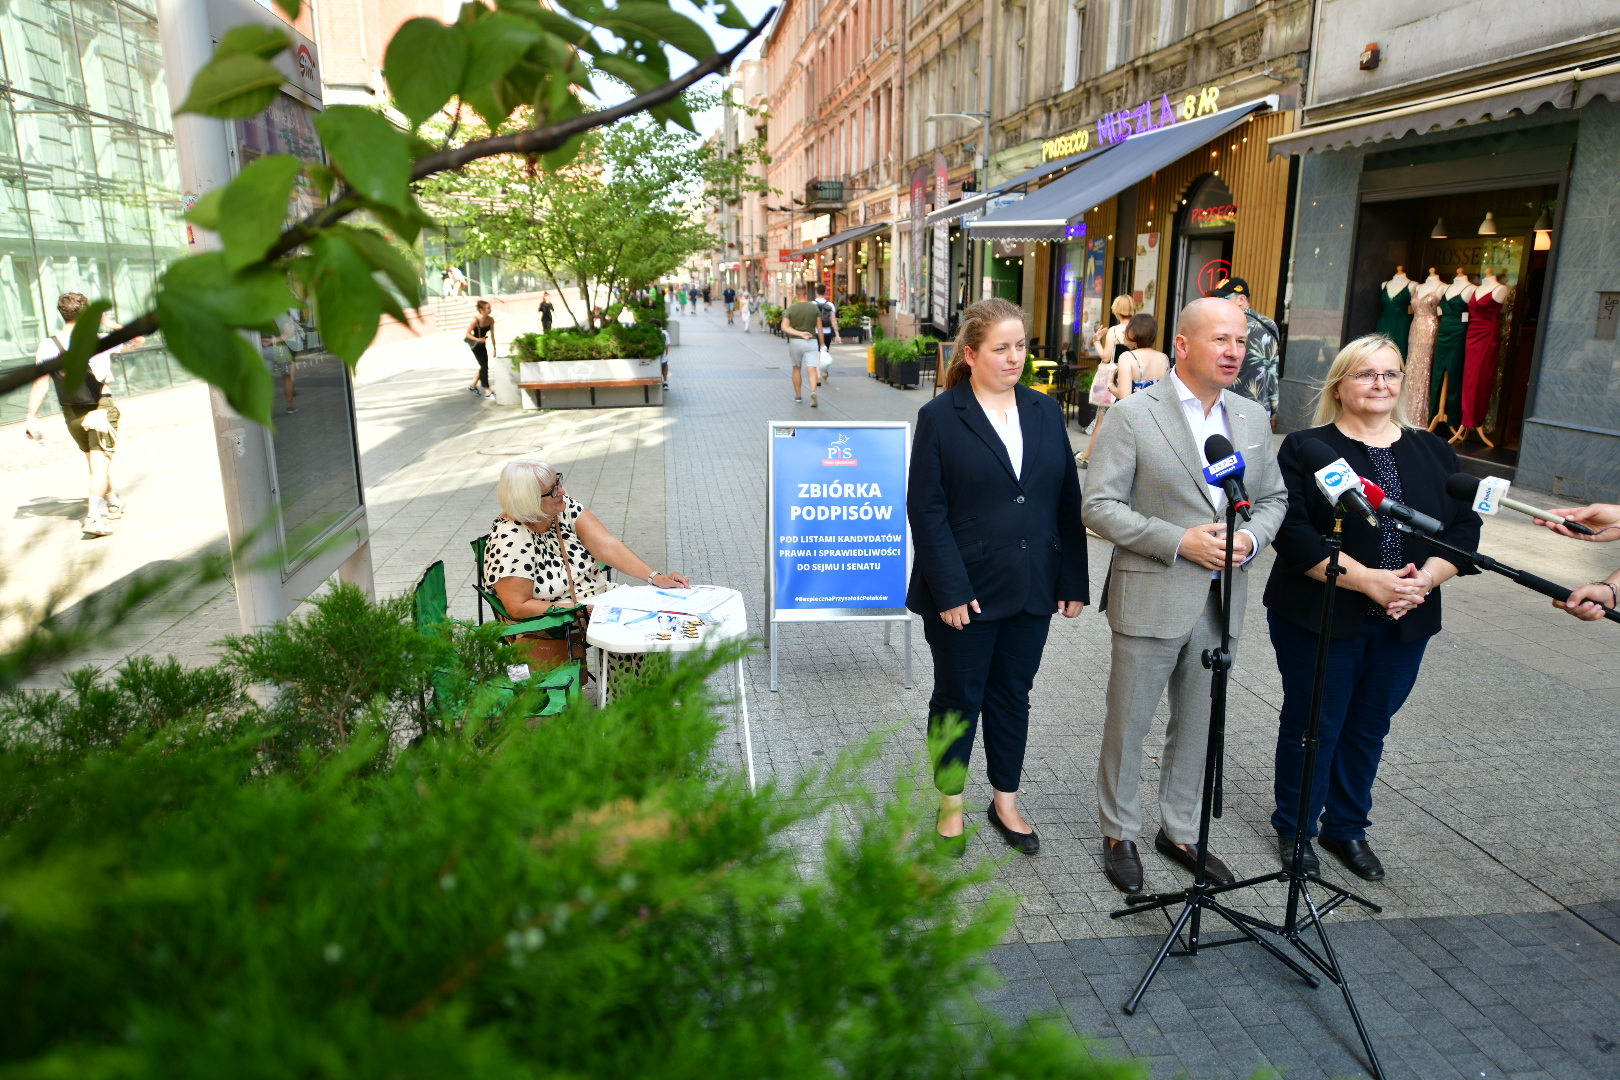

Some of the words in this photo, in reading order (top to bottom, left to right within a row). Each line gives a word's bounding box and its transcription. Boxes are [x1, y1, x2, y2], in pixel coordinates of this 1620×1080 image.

[1042, 129, 1089, 163] PROSECCO
[1097, 93, 1177, 146] MUSZLA
[1182, 86, 1220, 121] BAR
[1191, 204, 1238, 224] PROSECC
[1433, 247, 1512, 265] ROSSELLA
[797, 479, 882, 498] ZBIÓRKA
[790, 502, 893, 521] PODPISÓW
[779, 535, 799, 543] POD
[800, 535, 836, 543] LISTAMI
[837, 533, 902, 543] KANDYDATÓW
[779, 549, 812, 557] PRAWA
[813, 549, 817, 557] I
[818, 547, 901, 557] SPRAWIEDLIWOŚCI
[797, 563, 810, 571] DO
[811, 563, 840, 573] SEJMU
[841, 563, 845, 571] I
[846, 562, 881, 571] SENATU
